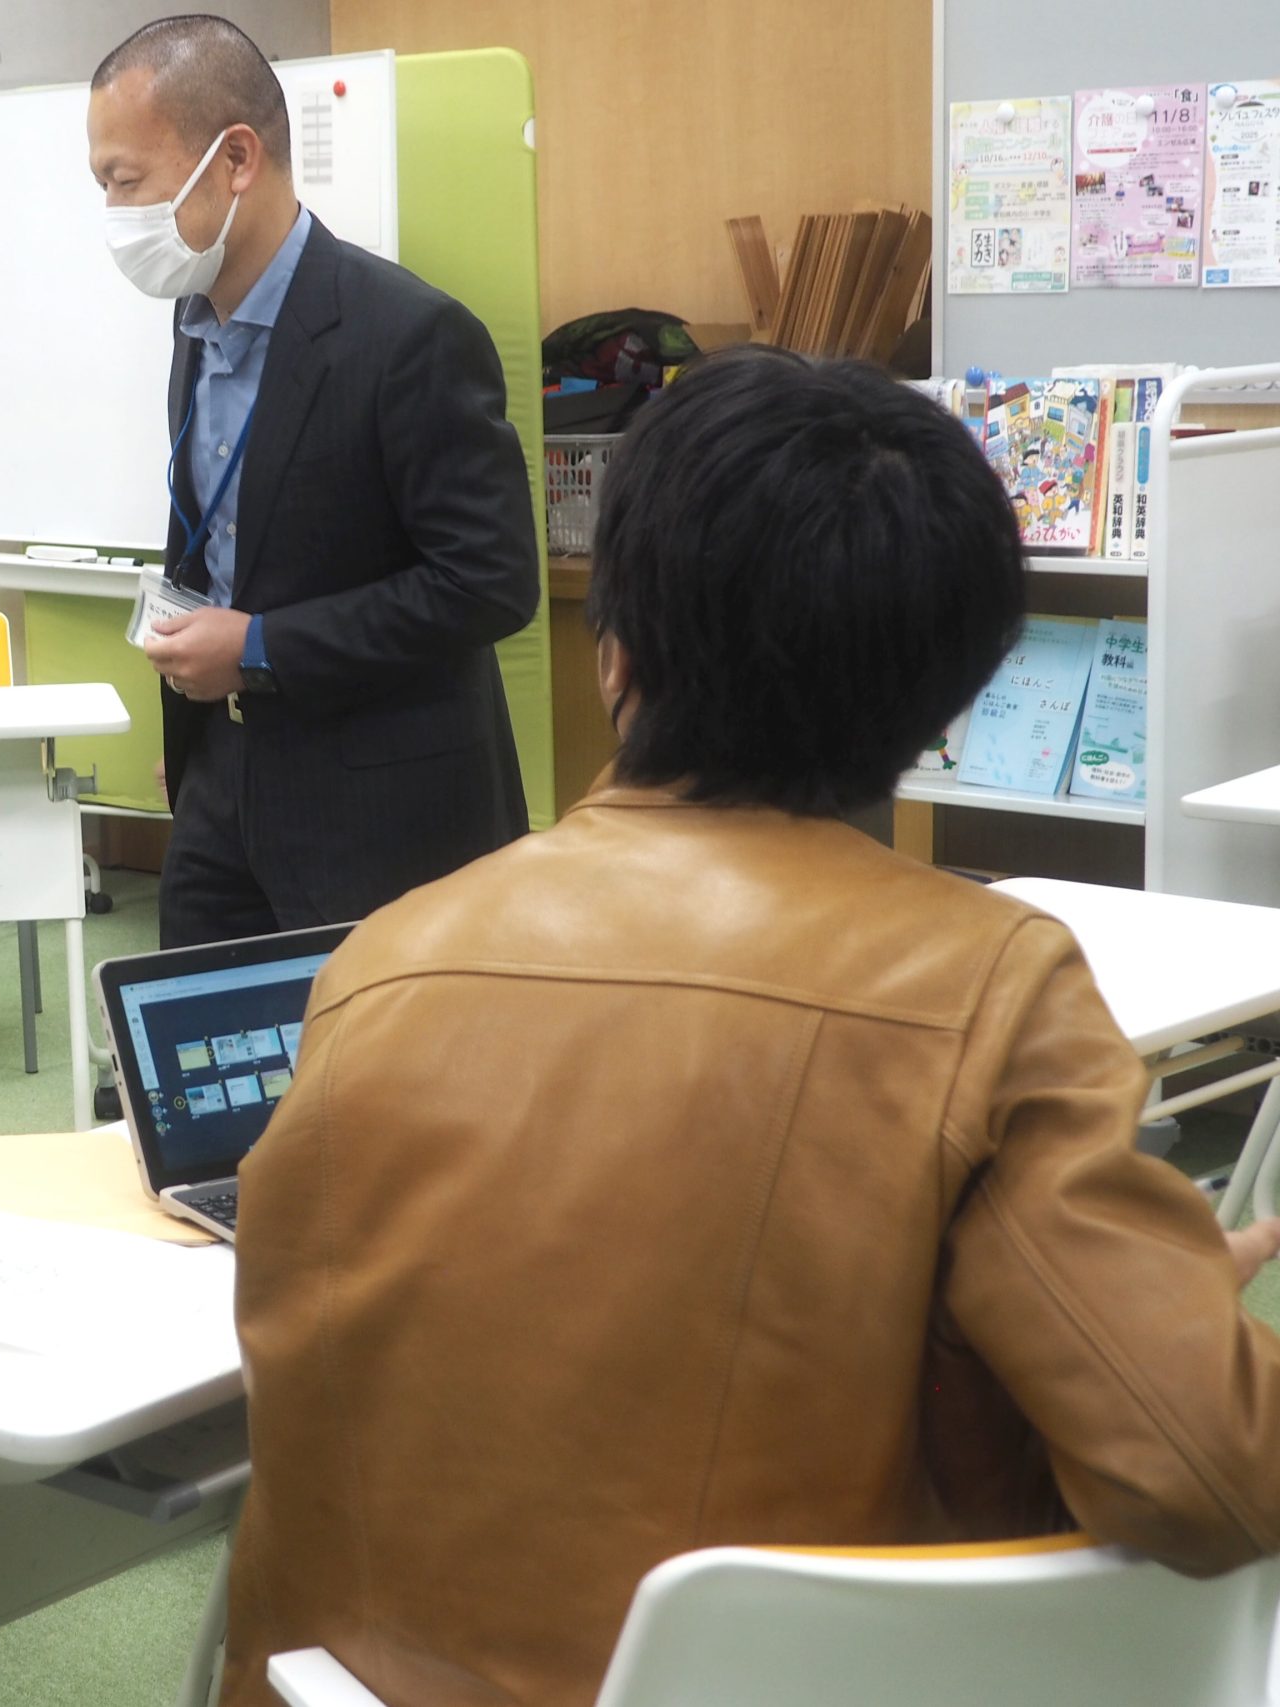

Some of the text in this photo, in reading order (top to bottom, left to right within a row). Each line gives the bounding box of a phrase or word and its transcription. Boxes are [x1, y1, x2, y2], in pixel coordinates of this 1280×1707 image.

[1111, 494, 1123, 539] 英和辞典
[1135, 494, 1147, 539] 和英辞典
[1010, 675, 1054, 690] にほんご
